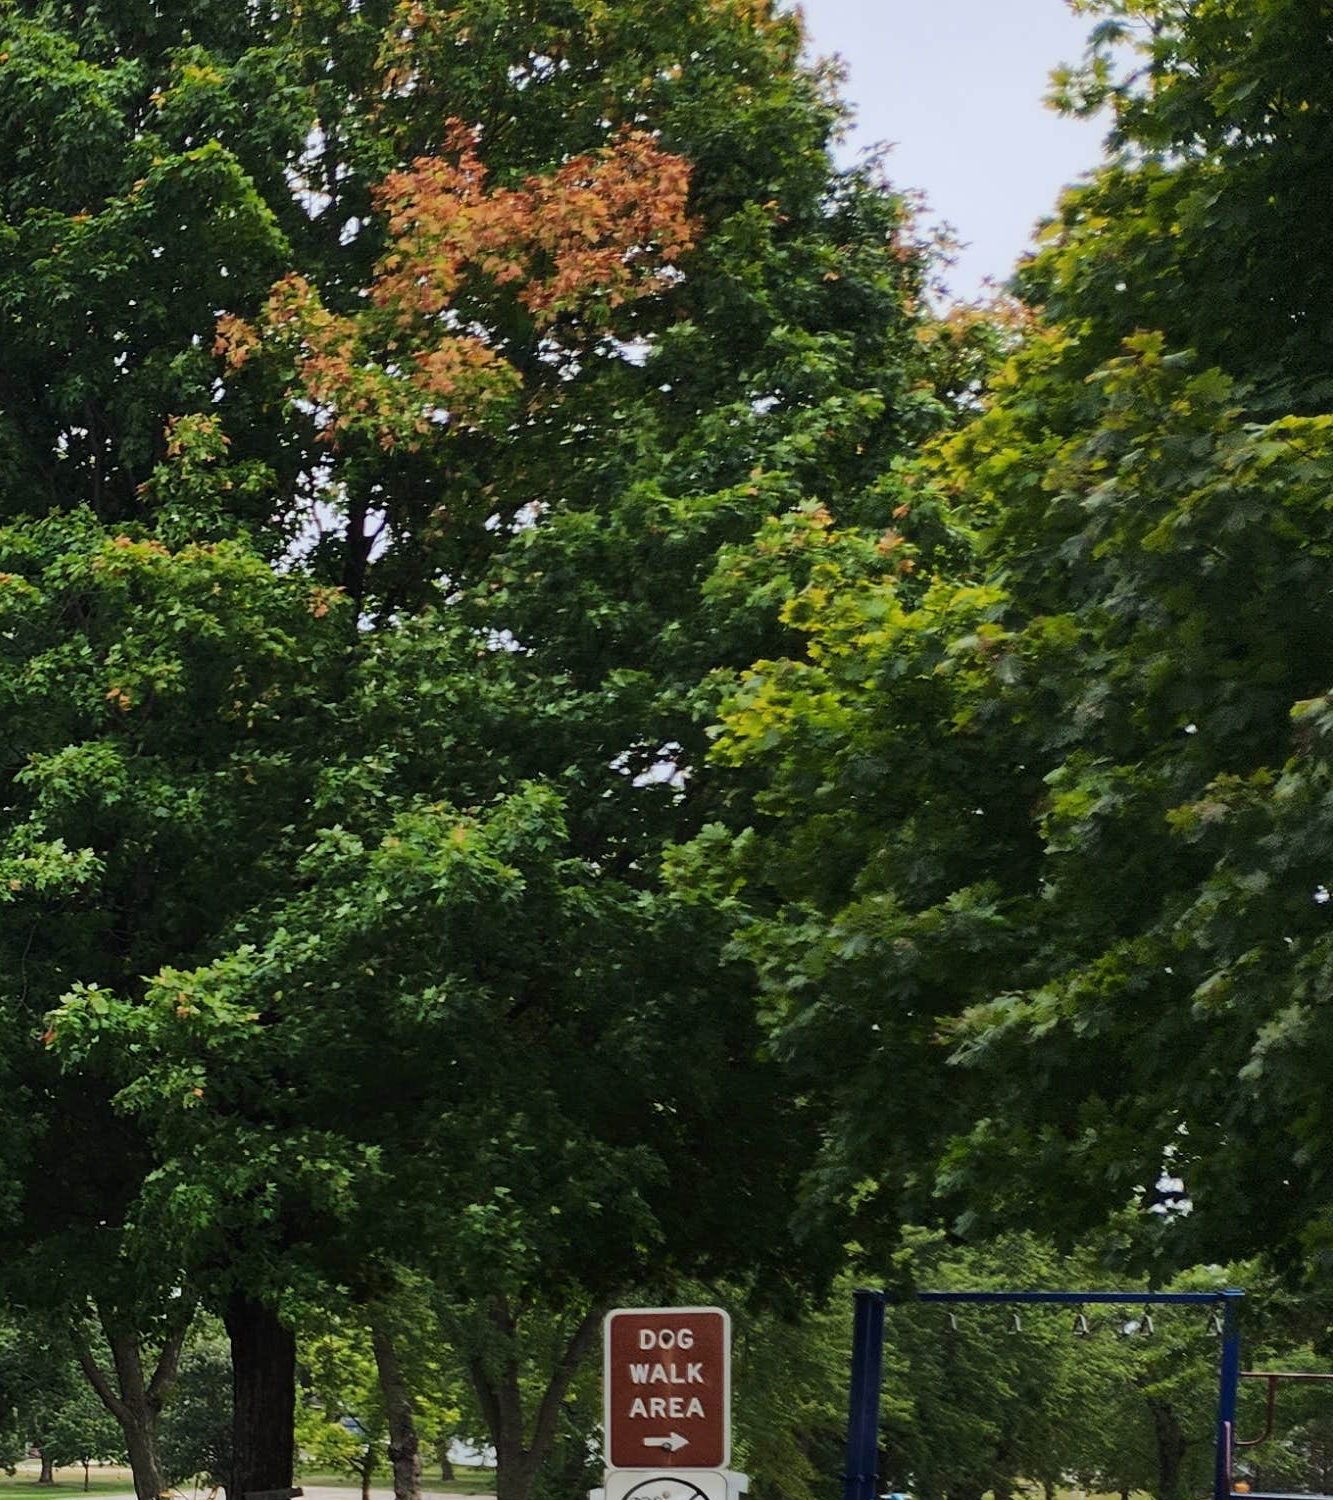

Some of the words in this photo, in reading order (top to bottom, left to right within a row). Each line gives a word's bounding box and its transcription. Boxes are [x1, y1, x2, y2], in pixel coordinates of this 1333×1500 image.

[639, 1328, 694, 1350] DOG
[629, 1363, 704, 1384] WALK
[629, 1397, 705, 1418] AREA
